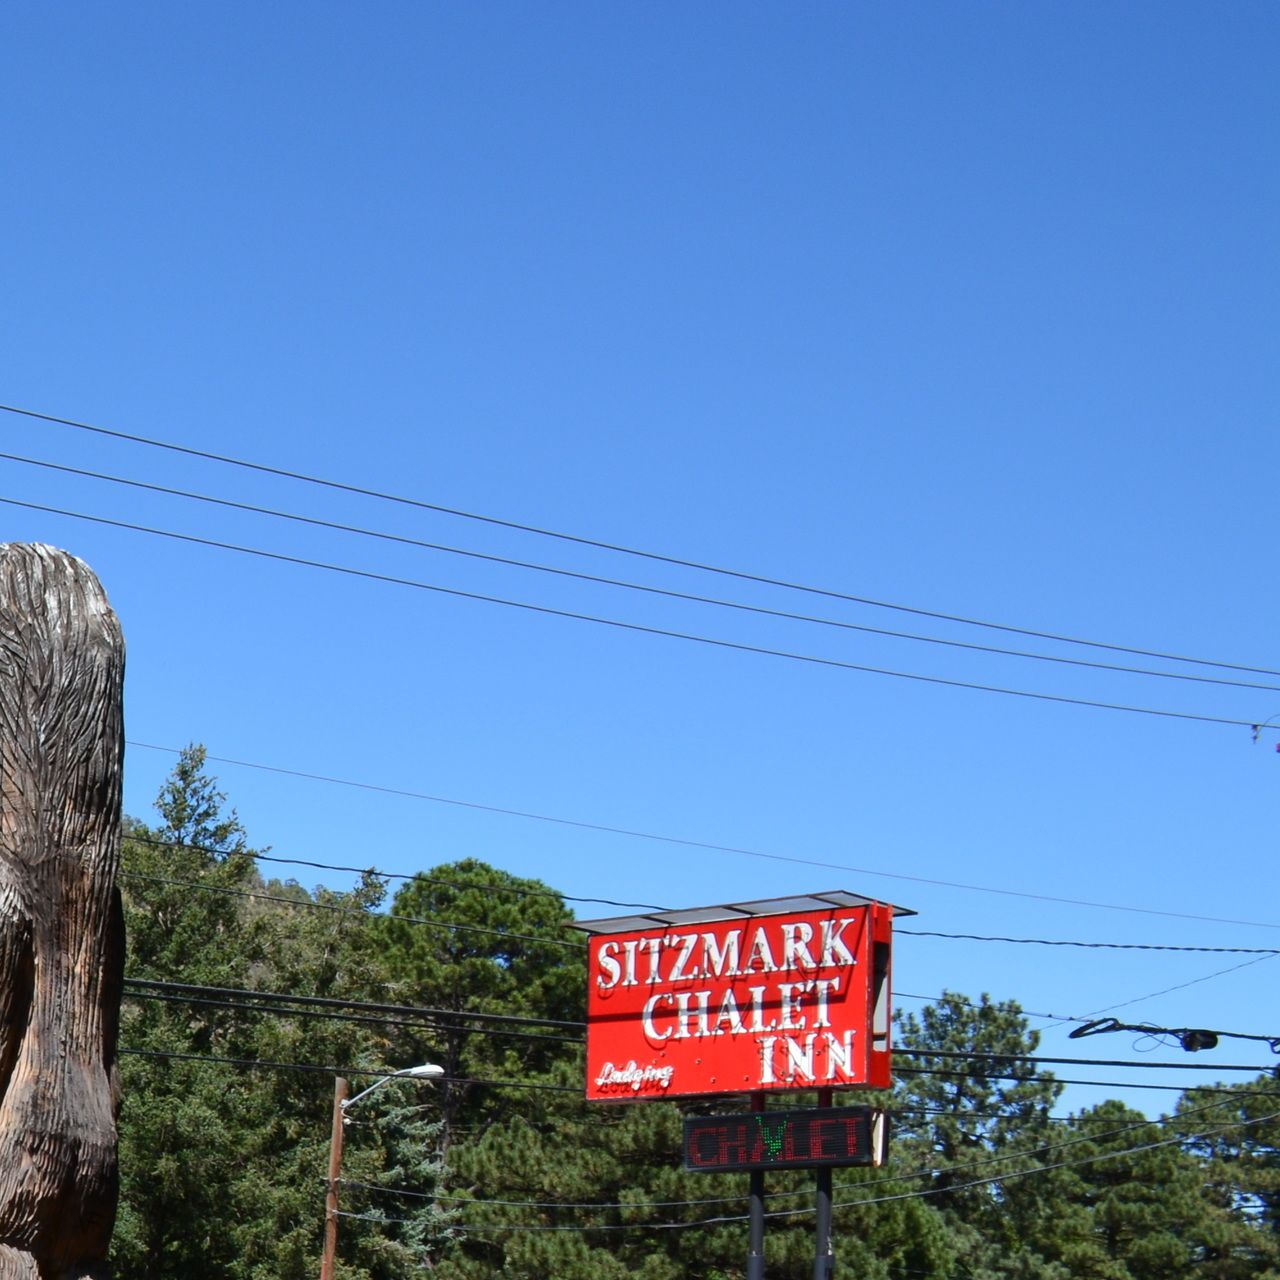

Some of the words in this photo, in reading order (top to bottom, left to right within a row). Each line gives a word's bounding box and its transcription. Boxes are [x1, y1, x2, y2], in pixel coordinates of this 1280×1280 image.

[596, 918, 857, 989] SITZMARK
[642, 977, 840, 1041] CHALET
[594, 1060, 674, 1090] Lodging
[756, 1030, 857, 1084] INN
